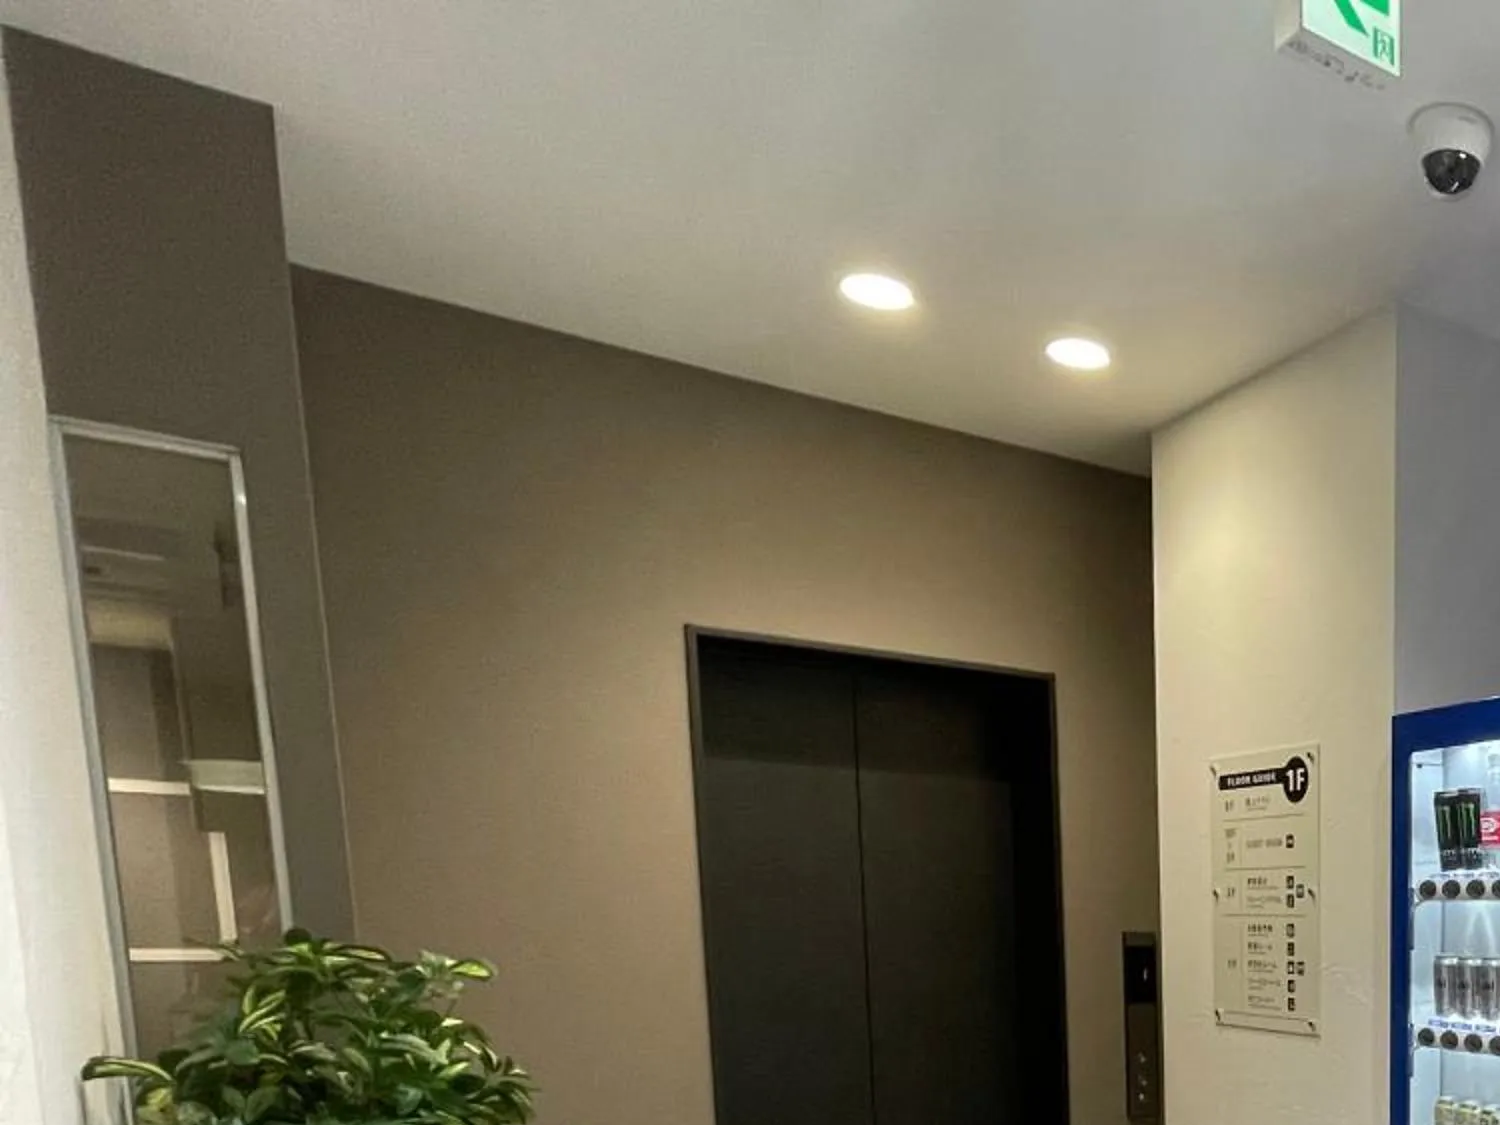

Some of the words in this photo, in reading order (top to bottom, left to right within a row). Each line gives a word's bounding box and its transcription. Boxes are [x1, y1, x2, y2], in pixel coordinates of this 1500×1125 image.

[1227, 775, 1251, 787] FLOOR
[1253, 772, 1275, 783] GUIDE
[1286, 767, 1305, 792] 1F
